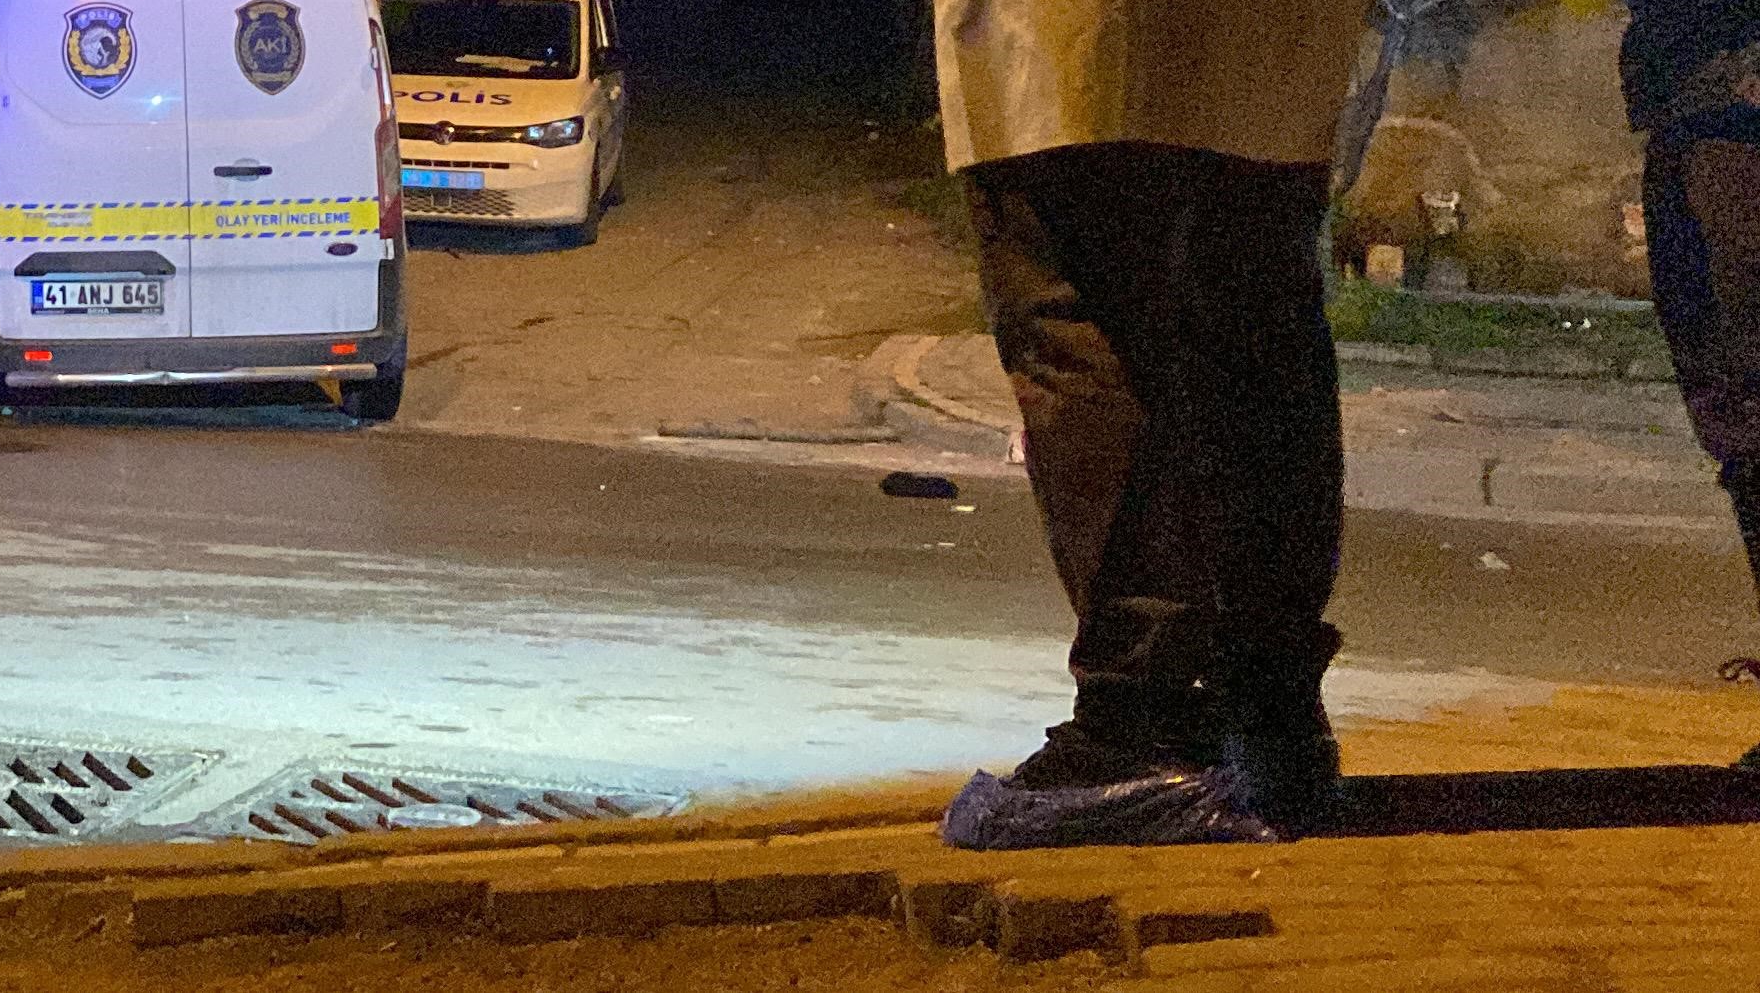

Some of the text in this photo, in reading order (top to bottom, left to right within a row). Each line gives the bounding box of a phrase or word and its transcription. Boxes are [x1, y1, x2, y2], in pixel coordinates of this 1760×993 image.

[215, 214, 250, 227] OLAY
[45, 283, 159, 305] 41 ANJ 645
